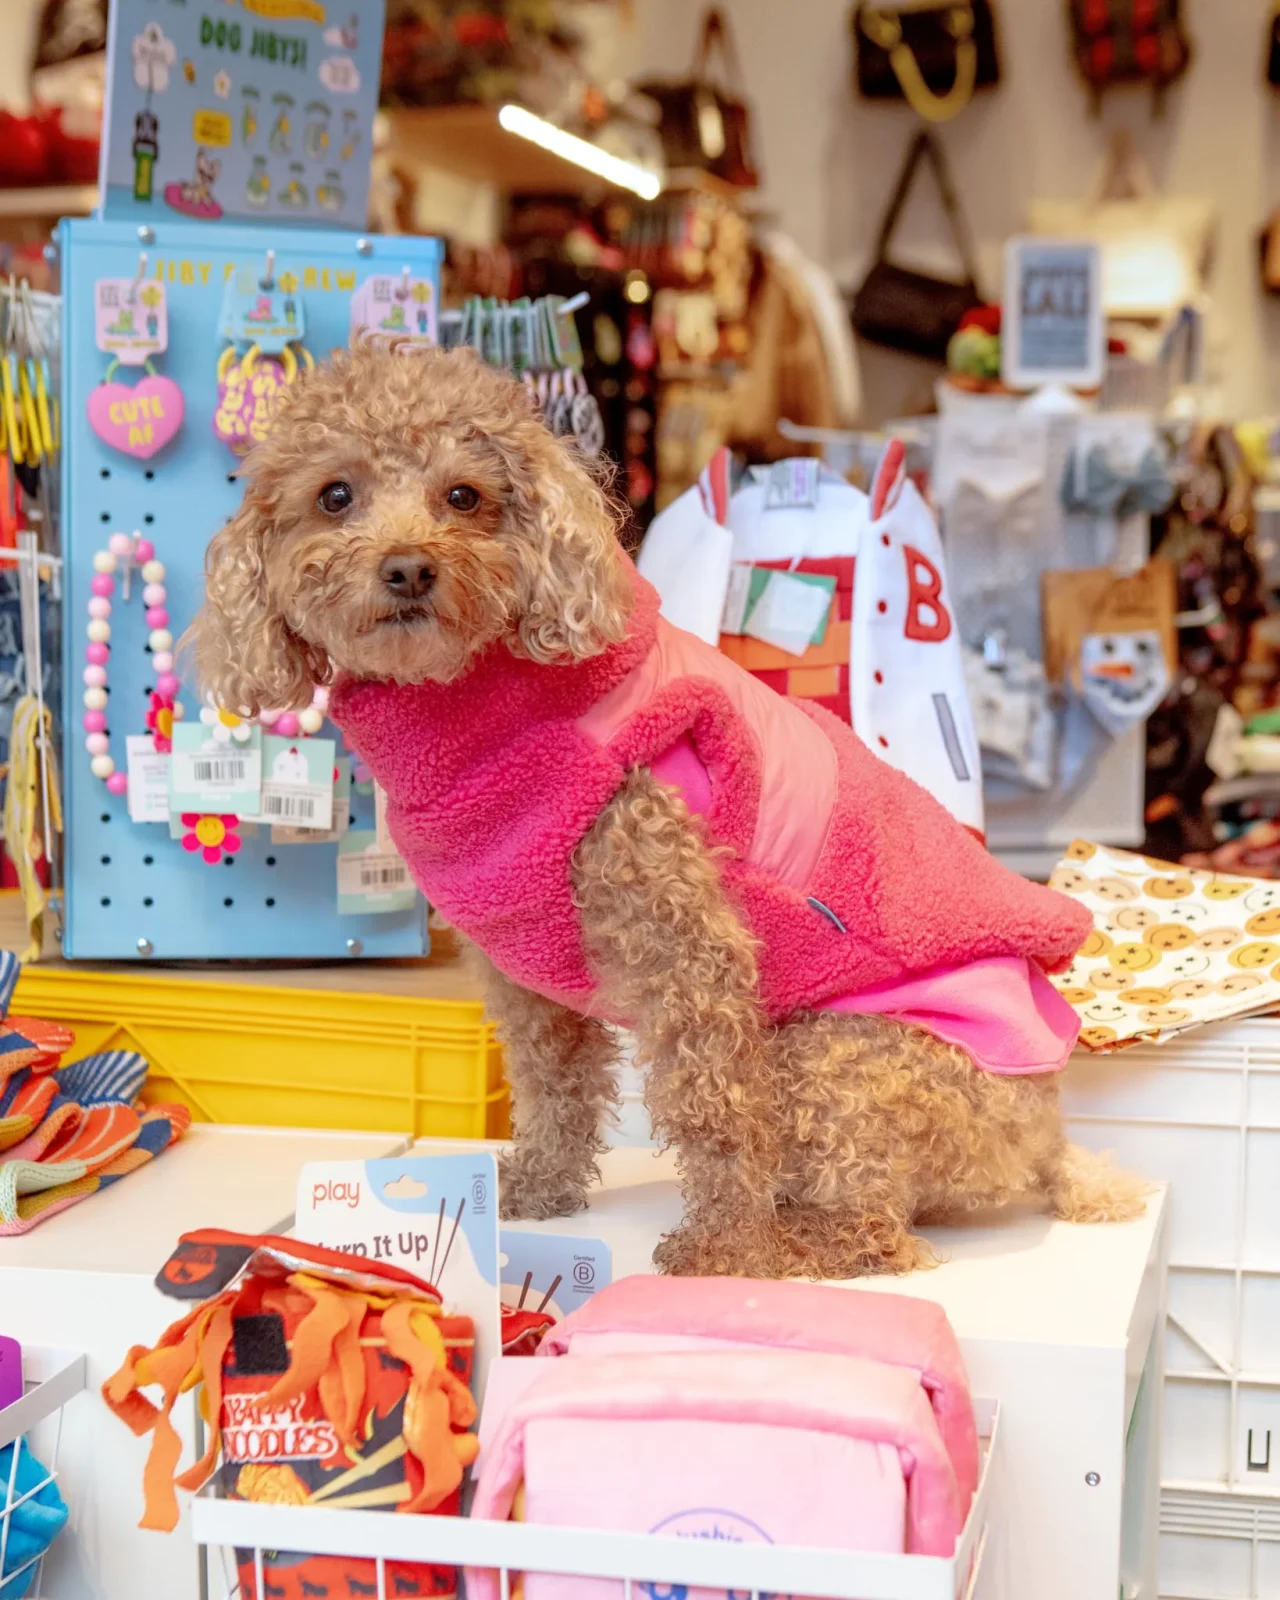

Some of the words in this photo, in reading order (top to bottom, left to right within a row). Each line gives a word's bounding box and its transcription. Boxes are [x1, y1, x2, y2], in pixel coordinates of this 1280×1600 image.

[109, 394, 165, 425] CUTE
[902, 543, 952, 644] B
[312, 1179, 361, 1211] play
[373, 1234, 393, 1259] It
[399, 1231, 429, 1262] Up
